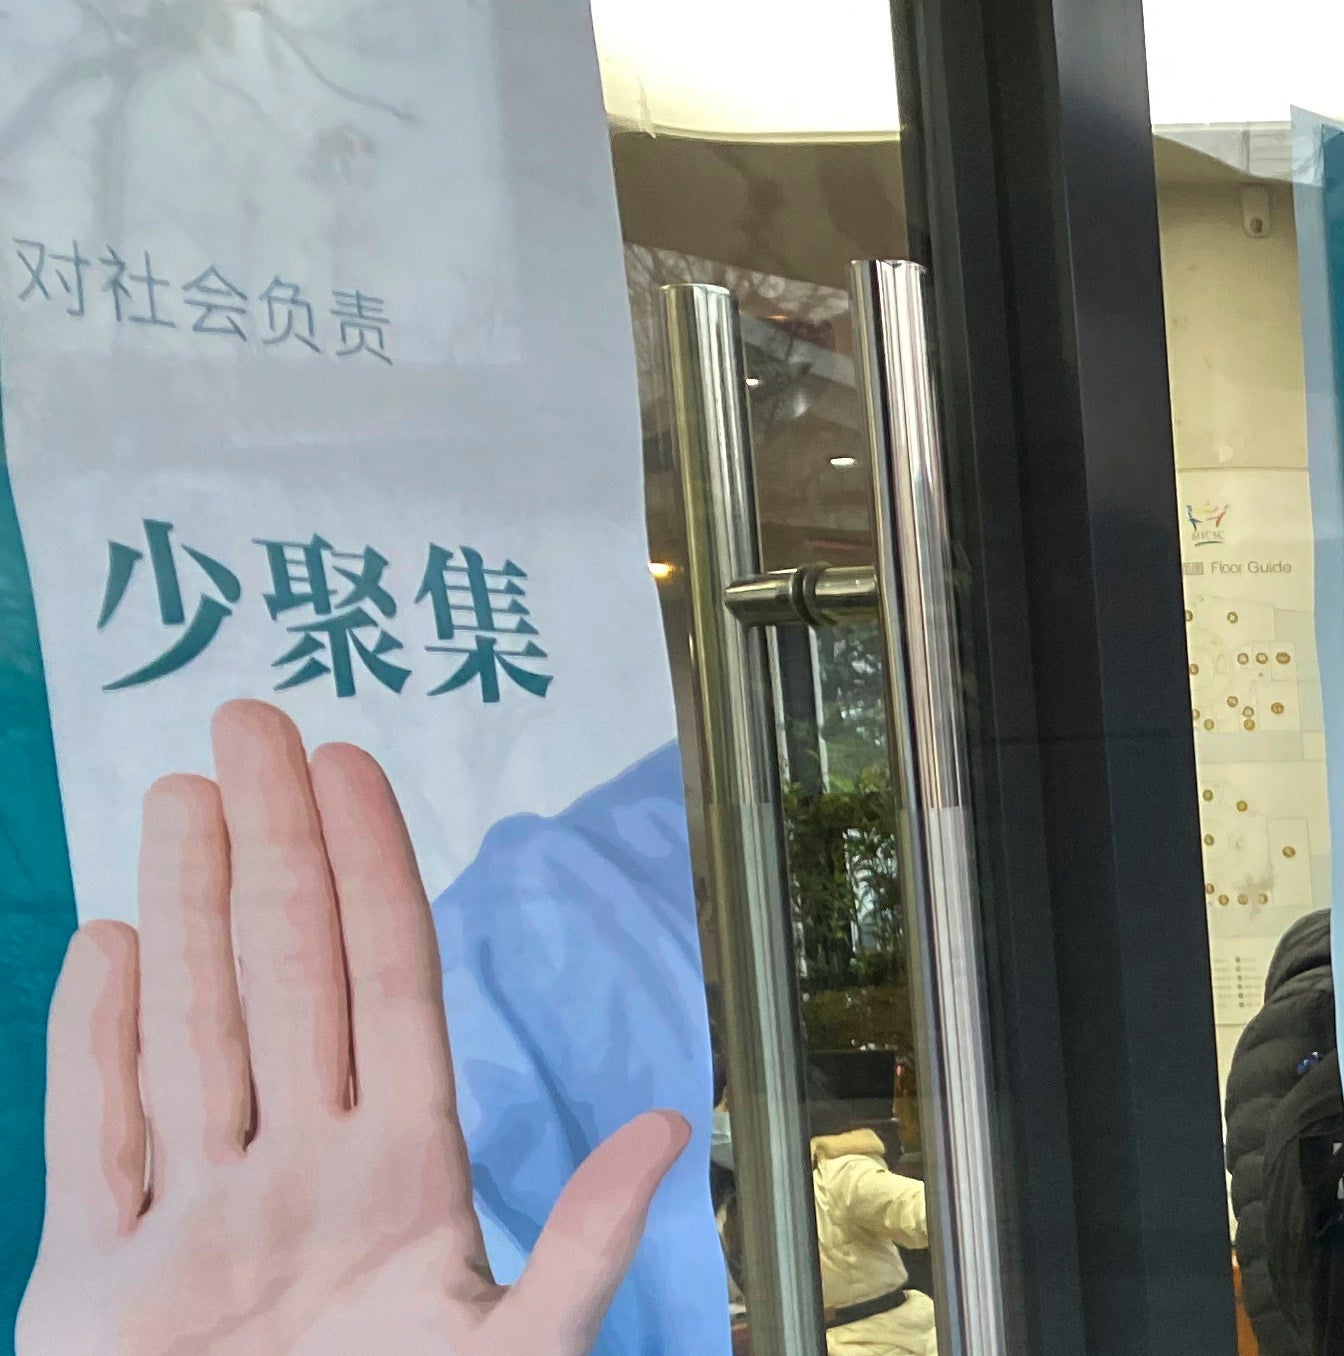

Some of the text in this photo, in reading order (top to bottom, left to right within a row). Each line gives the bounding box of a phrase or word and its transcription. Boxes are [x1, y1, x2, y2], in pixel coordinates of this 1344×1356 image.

[13, 237, 393, 365] 对社会负责
[96, 517, 554, 704] 少聚集
[1210, 561, 1243, 575] Floor
[1247, 560, 1293, 574] Guide
